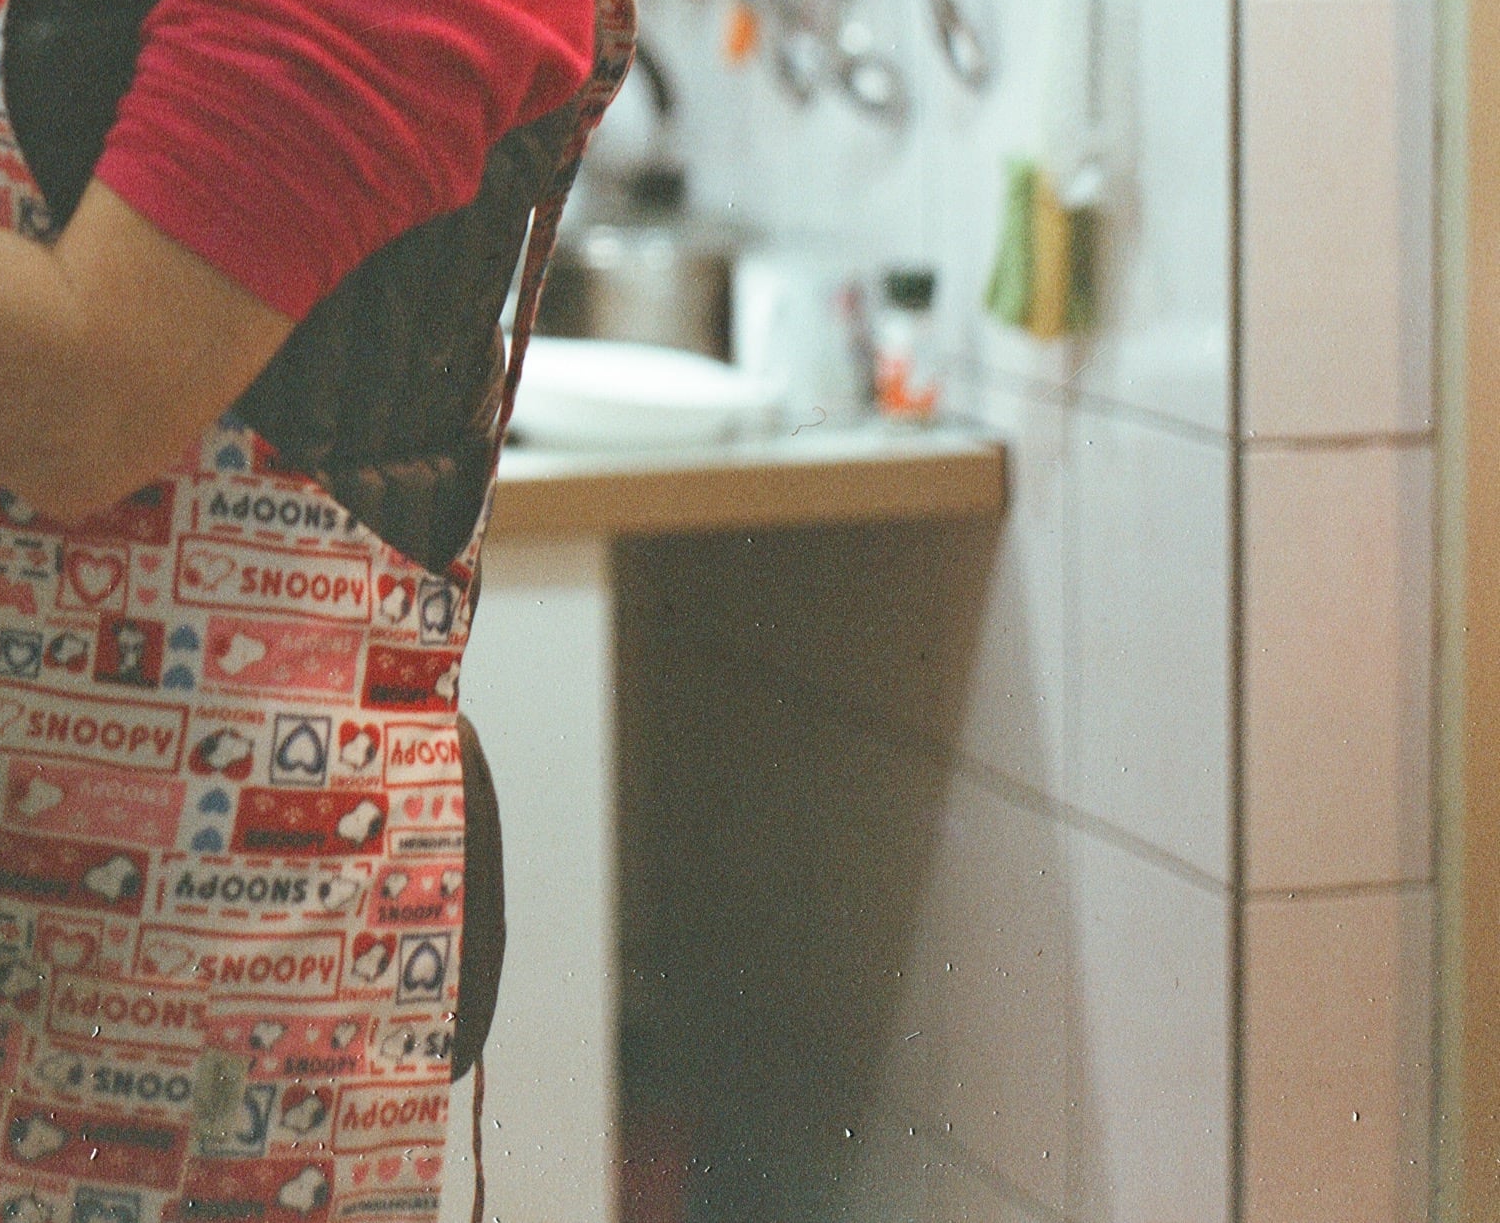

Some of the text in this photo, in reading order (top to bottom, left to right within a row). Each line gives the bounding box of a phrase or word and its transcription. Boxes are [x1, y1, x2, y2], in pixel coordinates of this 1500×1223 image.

[207, 490, 336, 533] SNOOPY
[240, 567, 365, 608] SNOOPY
[26, 710, 174, 757] SNOOPY
[174, 872, 309, 905] SNOOPY
[376, 903, 444, 923] SNOOPY
[199, 953, 336, 985] SNOOPY
